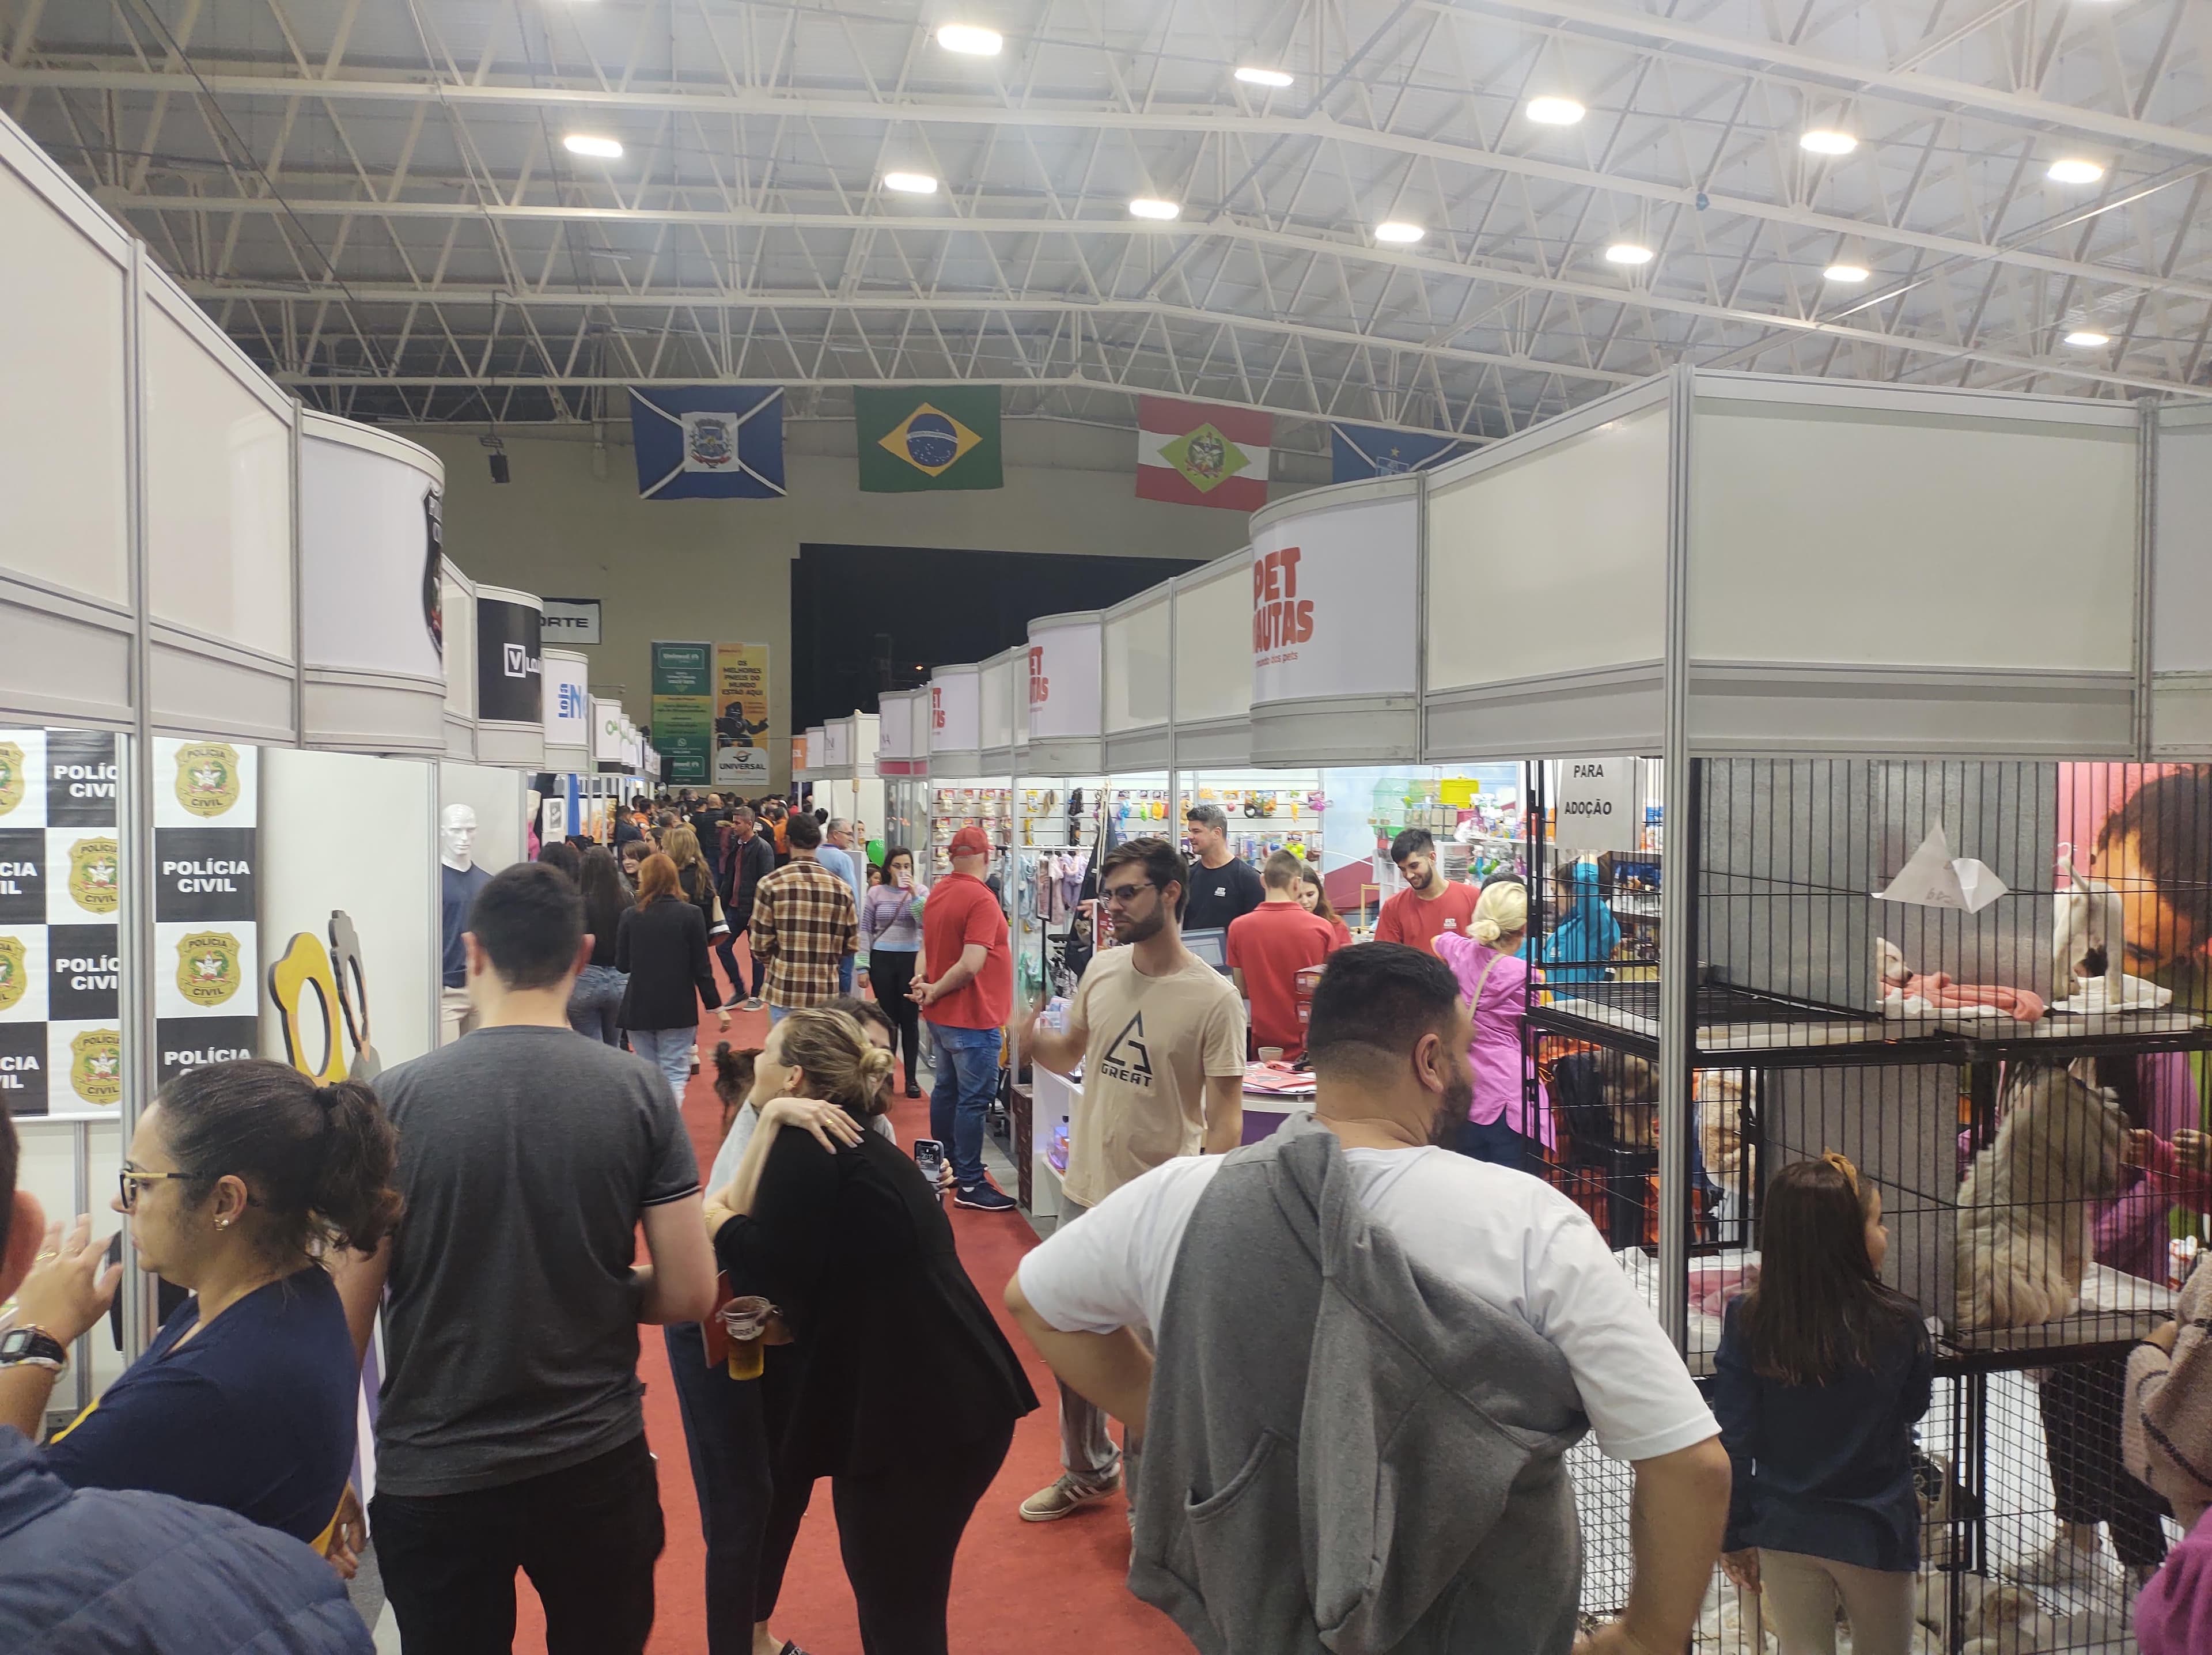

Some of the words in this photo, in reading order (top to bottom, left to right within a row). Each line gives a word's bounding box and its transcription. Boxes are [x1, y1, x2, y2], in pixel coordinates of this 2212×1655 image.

[53, 762, 119, 780] POLÍC
[1574, 764, 1604, 778] PARA
[69, 783, 116, 798] CIVI
[1565, 798, 1612, 819] ADOÇÃO
[162, 858, 251, 875] POLÍCIA
[177, 878, 237, 893] CIVIL
[56, 955, 120, 972] POLÍC
[71, 975, 118, 990] CIVI
[164, 1047, 251, 1065] POLÍCIA
[1101, 1063, 1152, 1087] GREAT
